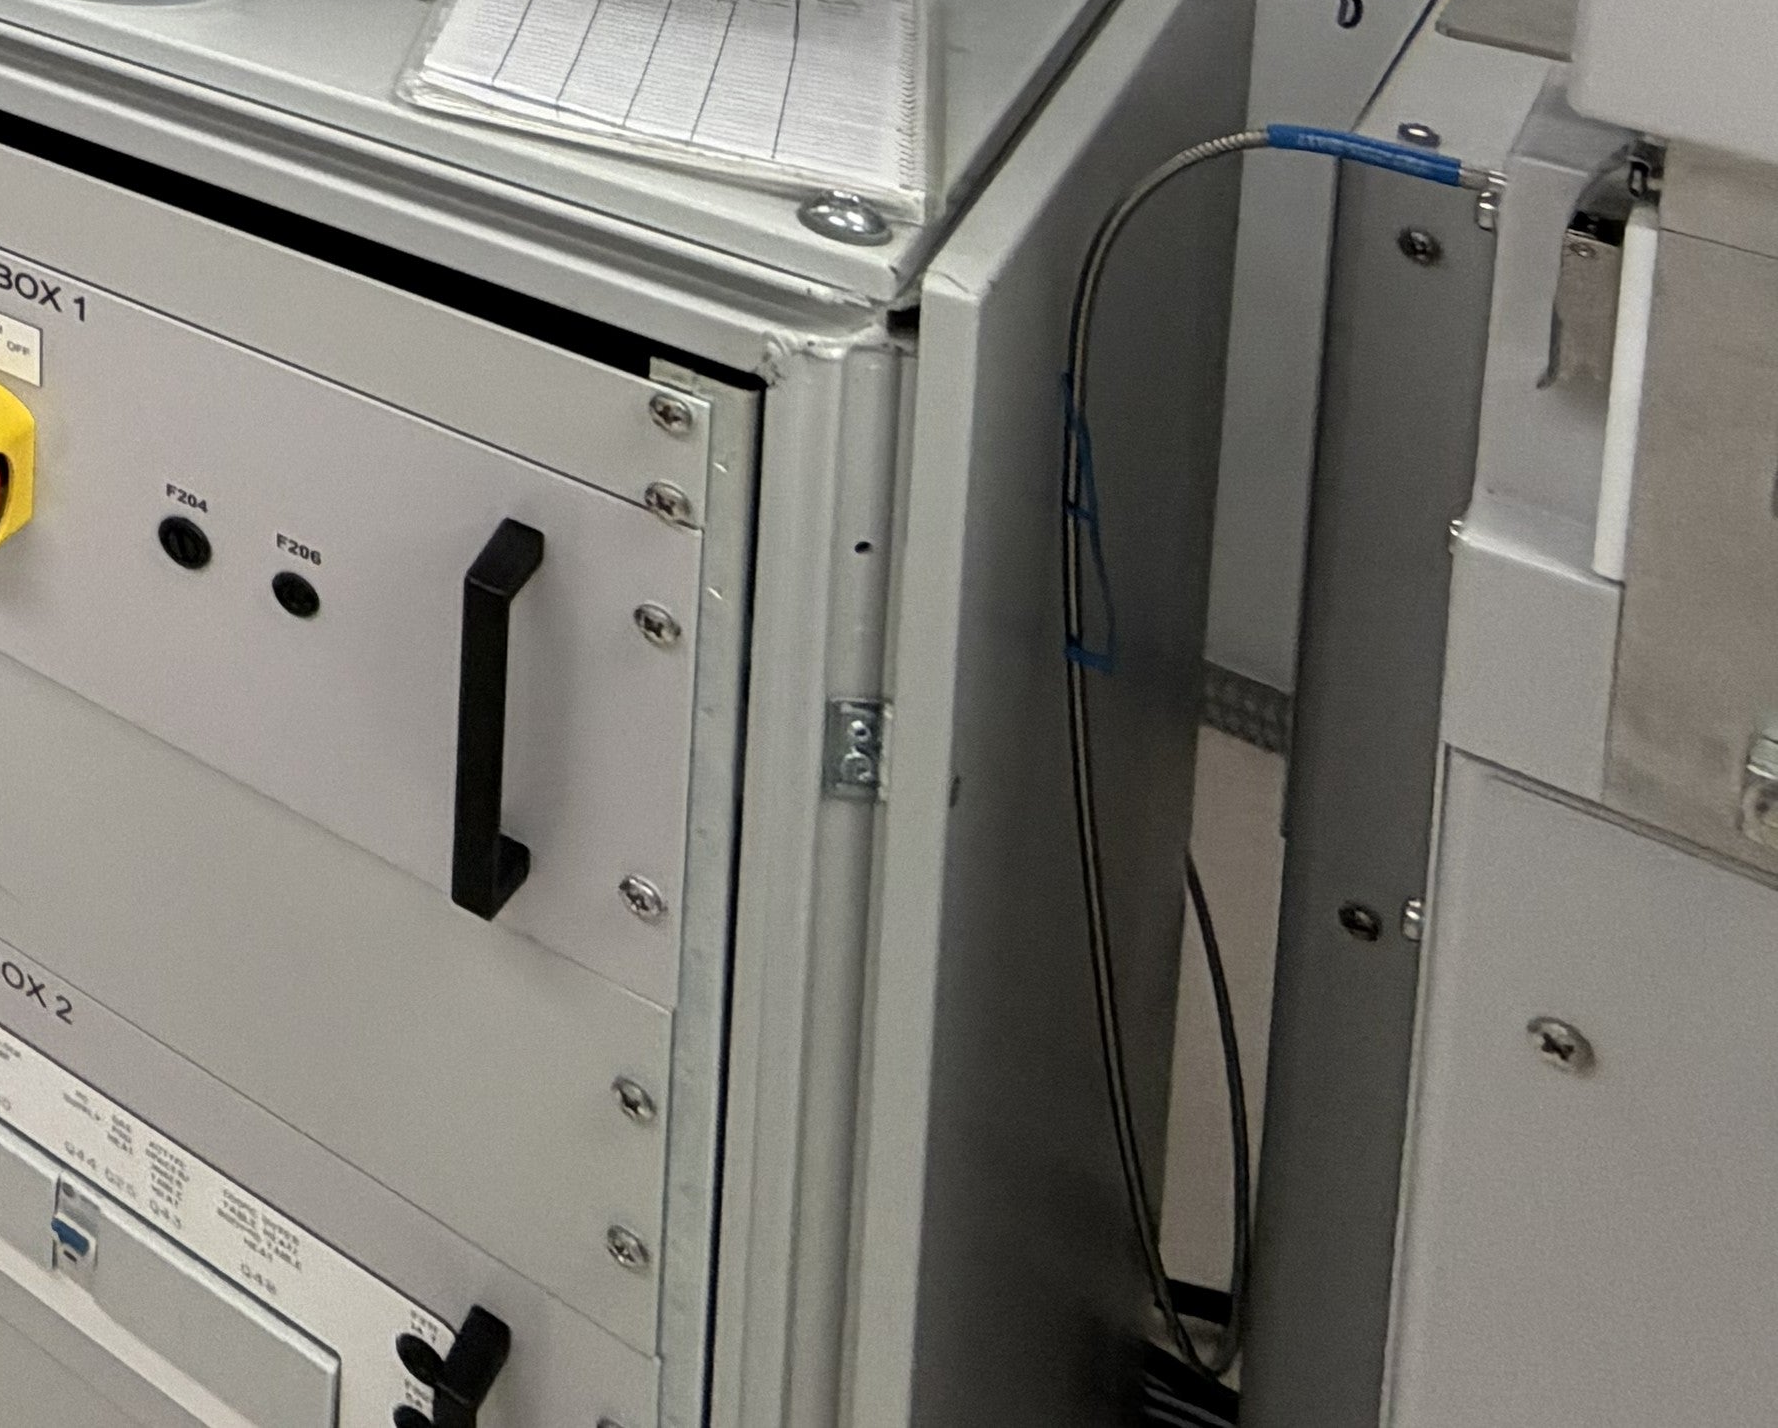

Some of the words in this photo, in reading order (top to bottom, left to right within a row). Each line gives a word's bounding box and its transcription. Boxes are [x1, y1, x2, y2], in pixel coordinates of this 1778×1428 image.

[73, 296, 85, 322] 1
[6, 340, 31, 356] OFF
[165, 483, 208, 514] F204
[276, 532, 322, 567] F206
[55, 995, 73, 1025] 2
